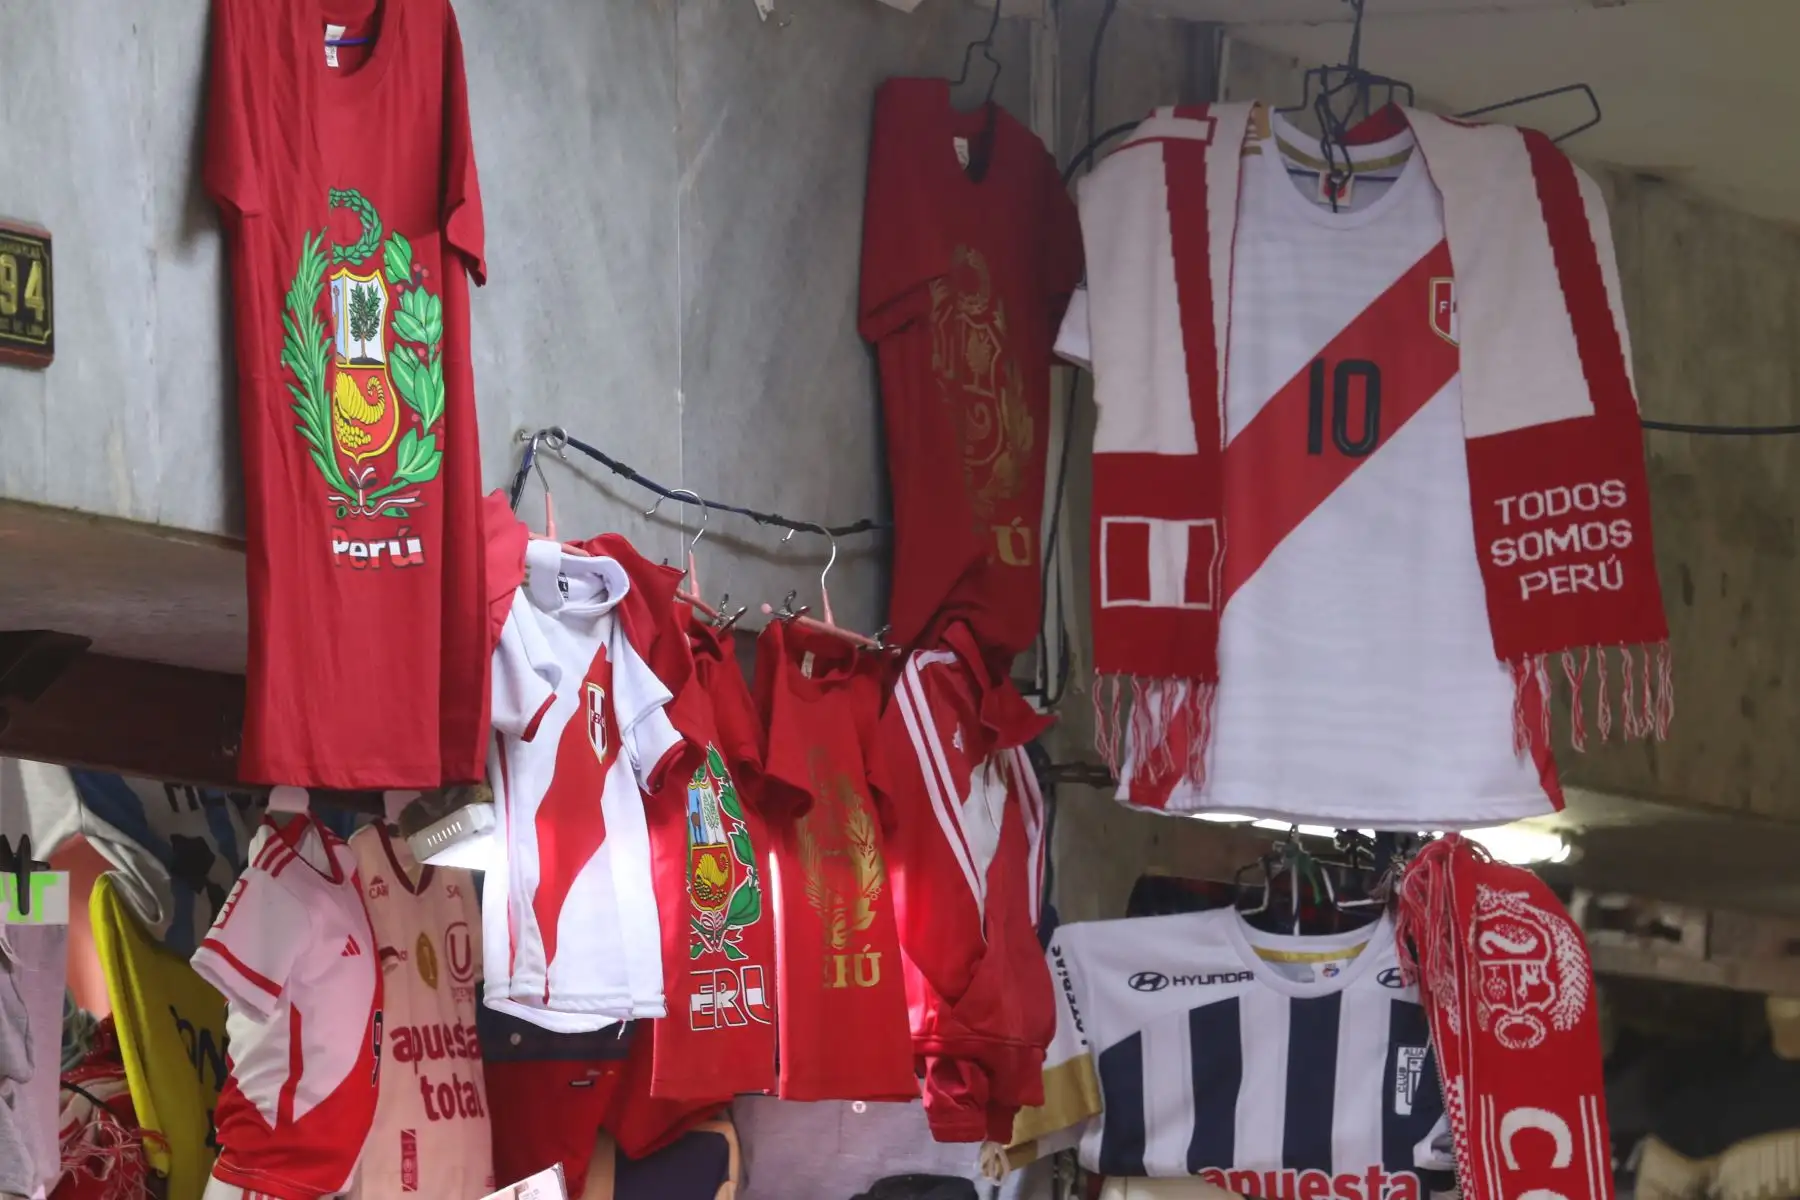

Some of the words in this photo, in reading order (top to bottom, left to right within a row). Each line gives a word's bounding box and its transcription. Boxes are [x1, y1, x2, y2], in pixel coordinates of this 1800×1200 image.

[1308, 358, 1381, 458] 10
[1494, 479, 1627, 526] TODOS
[331, 525, 425, 569] Perú
[1490, 518, 1633, 567] SOMOS
[1519, 554, 1624, 600] PERÚ
[1172, 971, 1254, 986] HYUNDAI
[420, 1073, 484, 1121] total
[1396, 1067, 1407, 1093] CLUB
